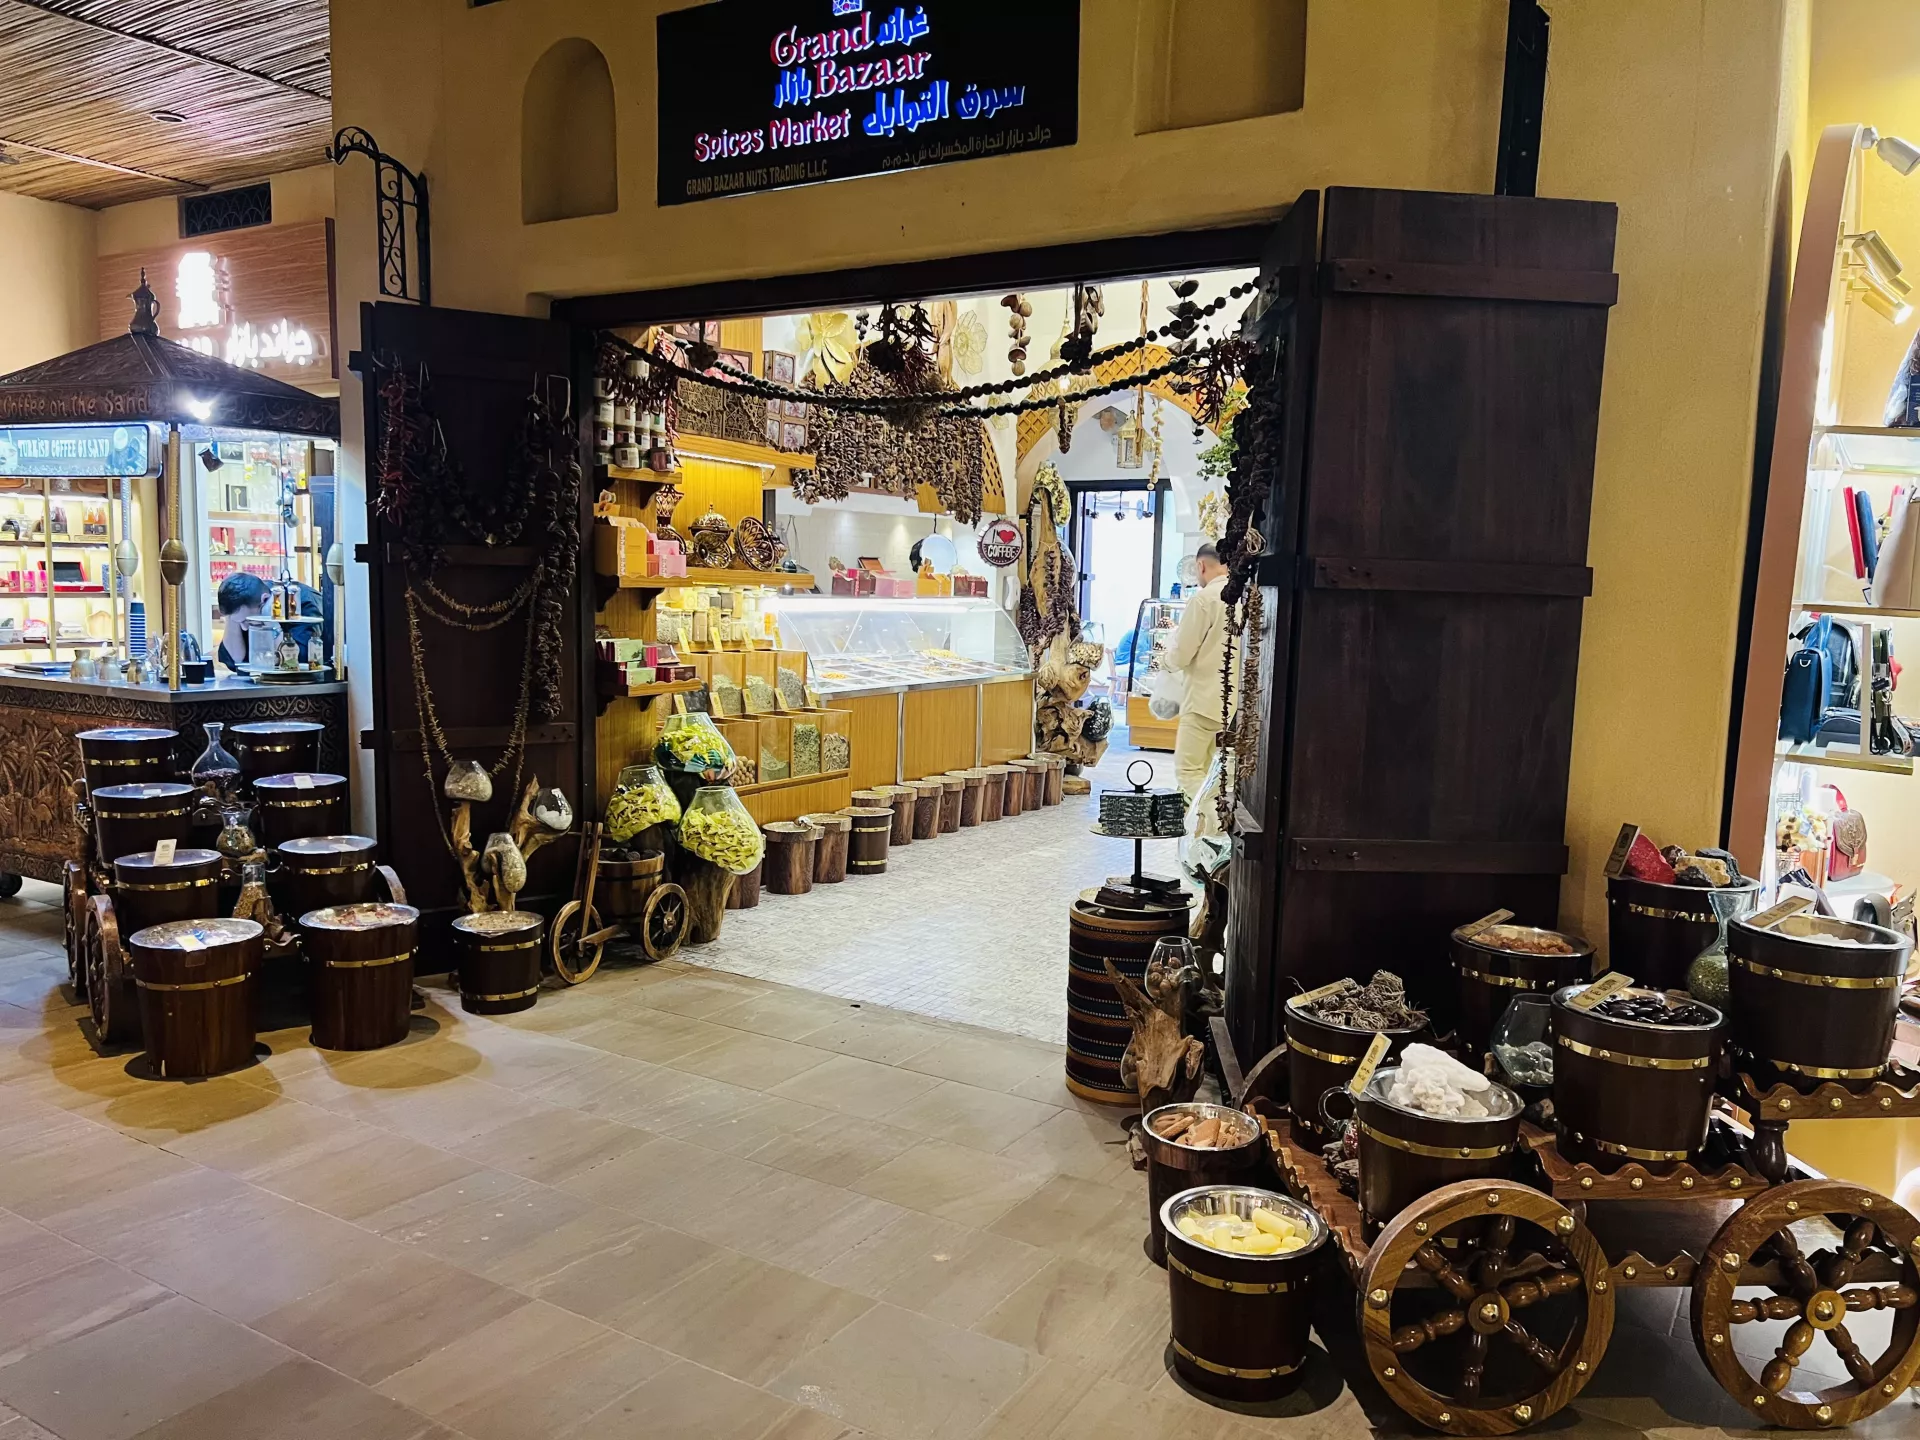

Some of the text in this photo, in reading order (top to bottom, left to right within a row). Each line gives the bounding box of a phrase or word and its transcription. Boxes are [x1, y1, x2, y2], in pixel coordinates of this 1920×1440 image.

[770, 11, 875, 67] Grand
[774, 66, 812, 108] بازار
[814, 52, 932, 99] Bazaar
[863, 80, 1026, 138] سوق التوابل
[694, 108, 852, 162] Spices Market
[686, 159, 828, 196] GRAND BAZAAR NUTS TRADING L.L.C
[3, 388, 150, 417] Coffee on the Sand
[51, 439, 77, 458] COFFEE
[87, 438, 110, 458] SAND
[988, 545, 1015, 558] COFFEE
